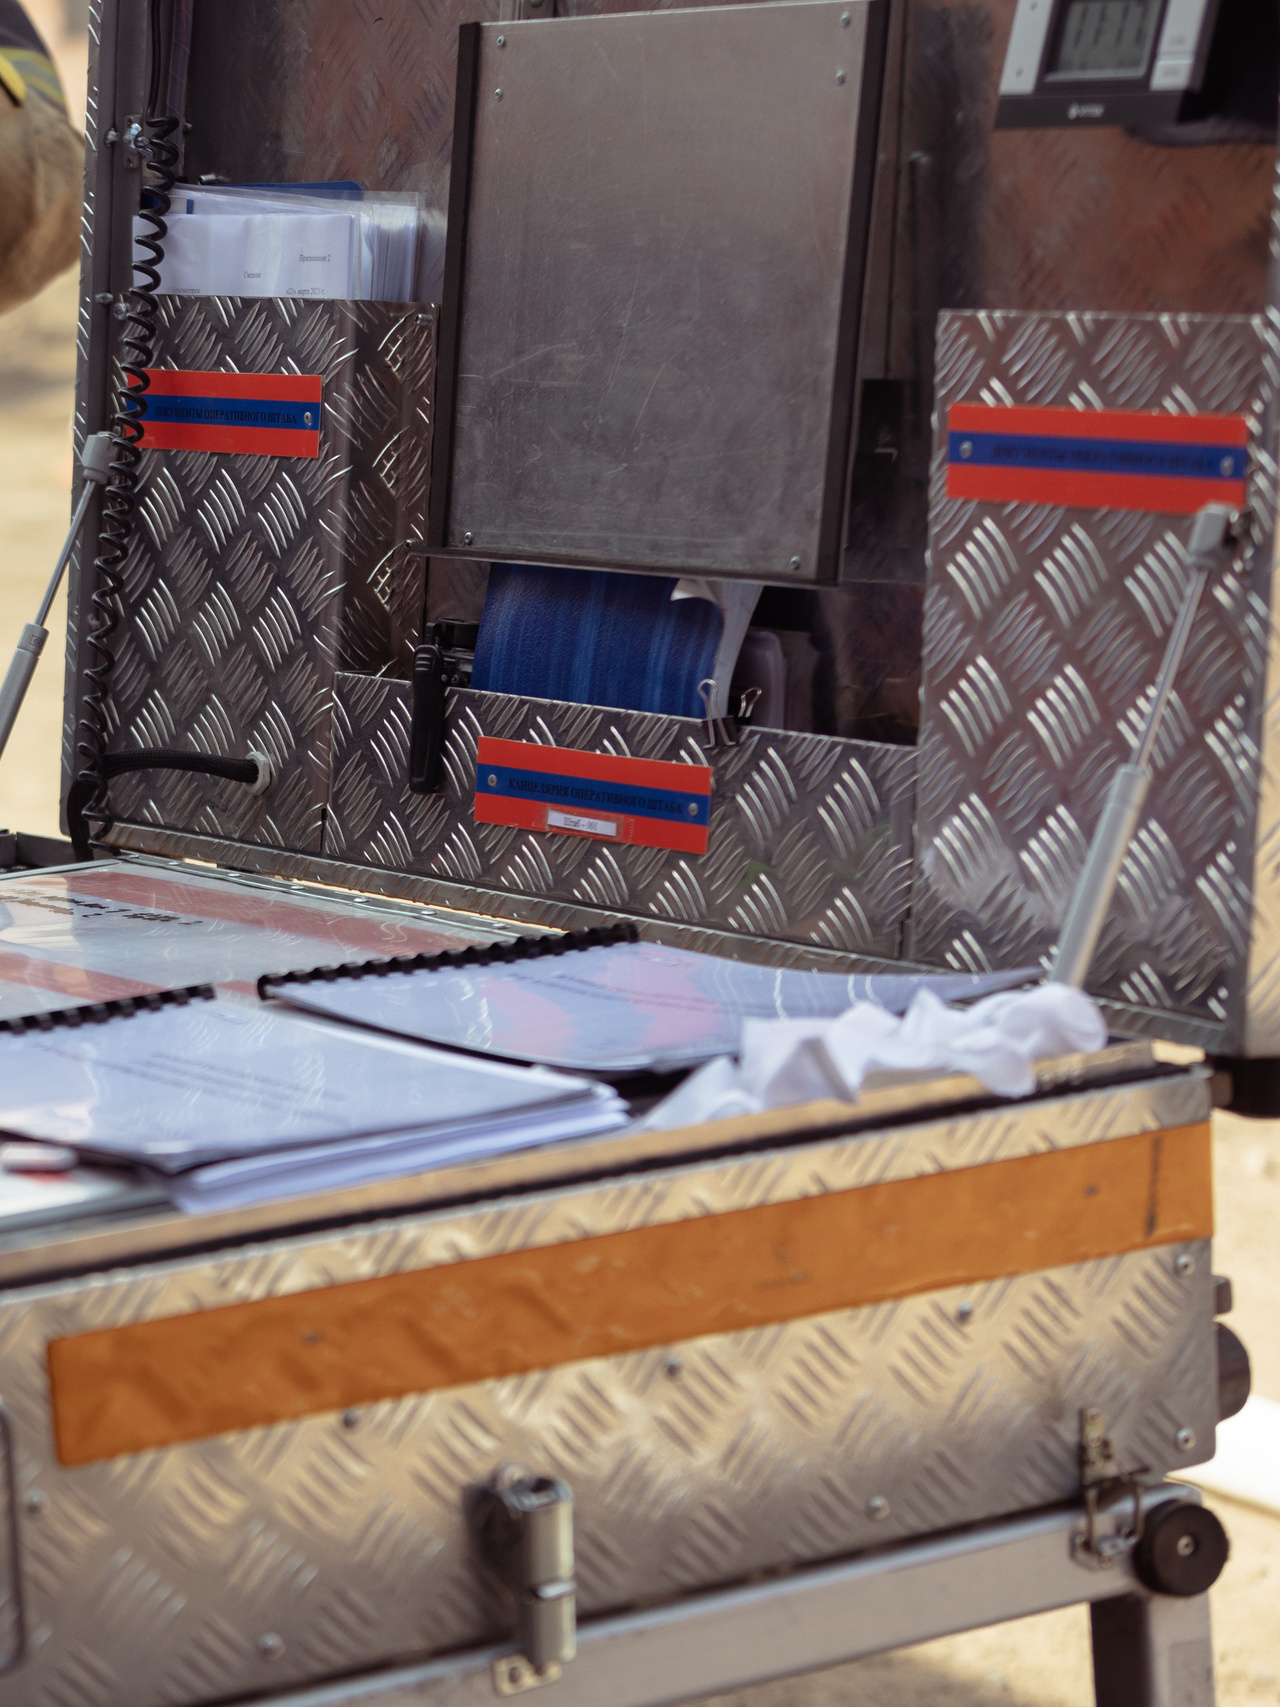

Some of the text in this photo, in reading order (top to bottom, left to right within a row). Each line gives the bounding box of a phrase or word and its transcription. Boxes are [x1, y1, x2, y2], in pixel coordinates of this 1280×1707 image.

[154, 406, 297, 424] ДОКУМЕНТЫ ОПЕРАТИВНОГО ШТАБА
[509, 778, 682, 814] КАНЦЕЛЯРИЯ ОПЕРАТИВНОГО ШТАБА
